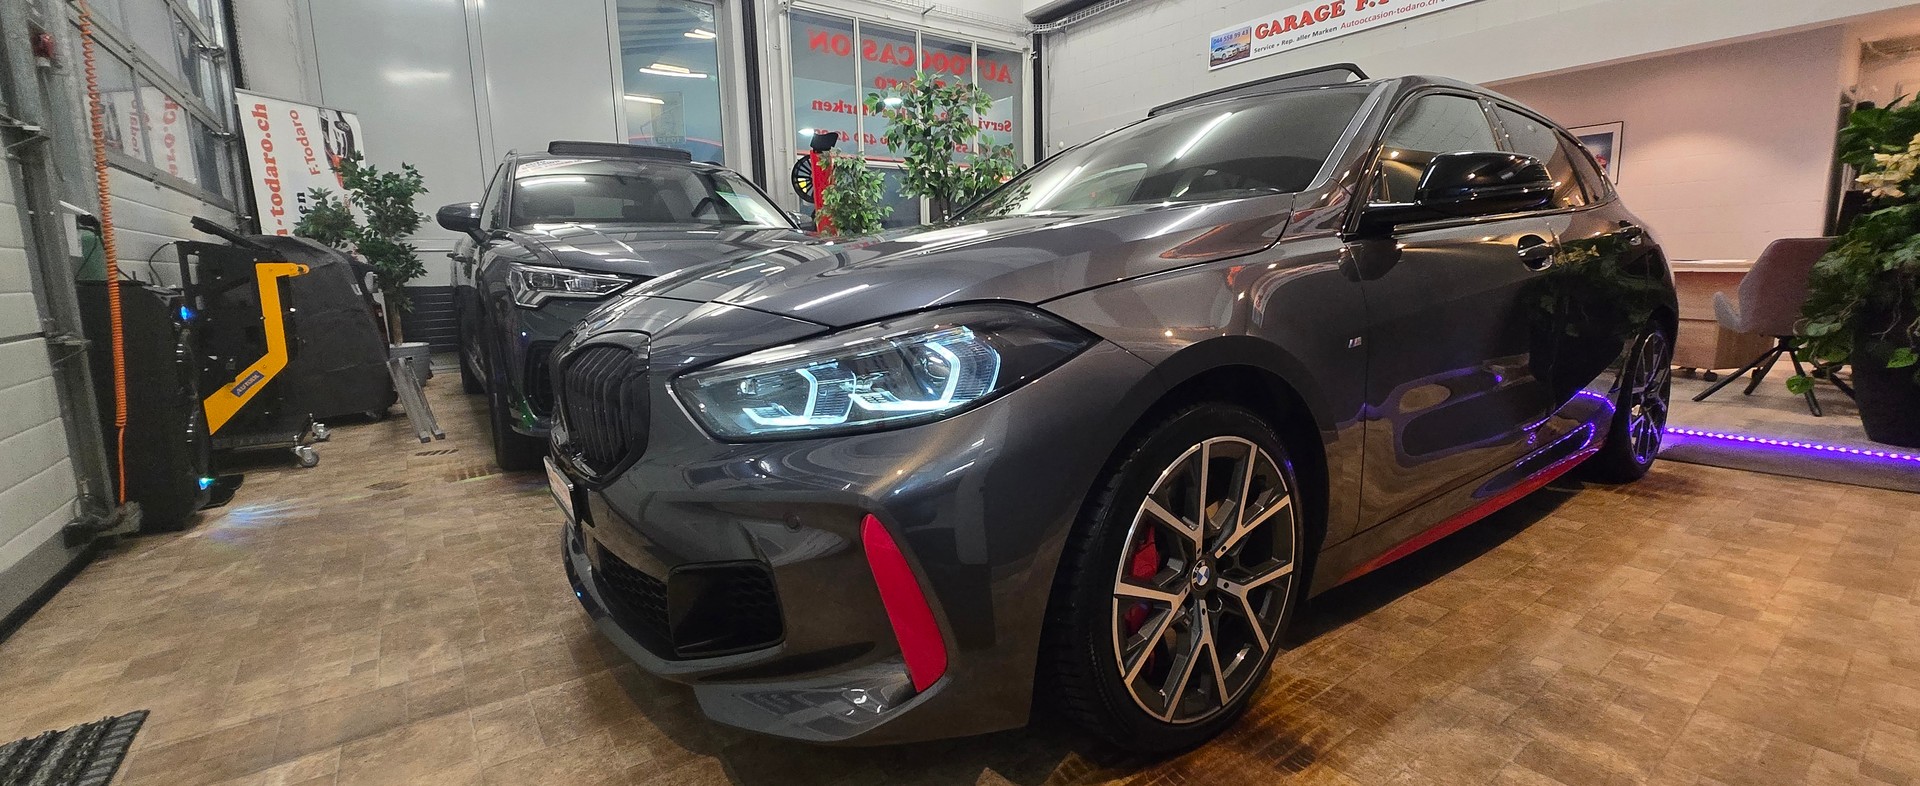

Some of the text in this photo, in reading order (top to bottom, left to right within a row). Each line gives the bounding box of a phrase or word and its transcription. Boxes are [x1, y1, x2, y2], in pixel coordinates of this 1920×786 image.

[1254, 0, 1438, 53] Service Rep. aller Marken Autooccasion-todaro.ch
[1255, 0, 1346, 40] GARAGE
